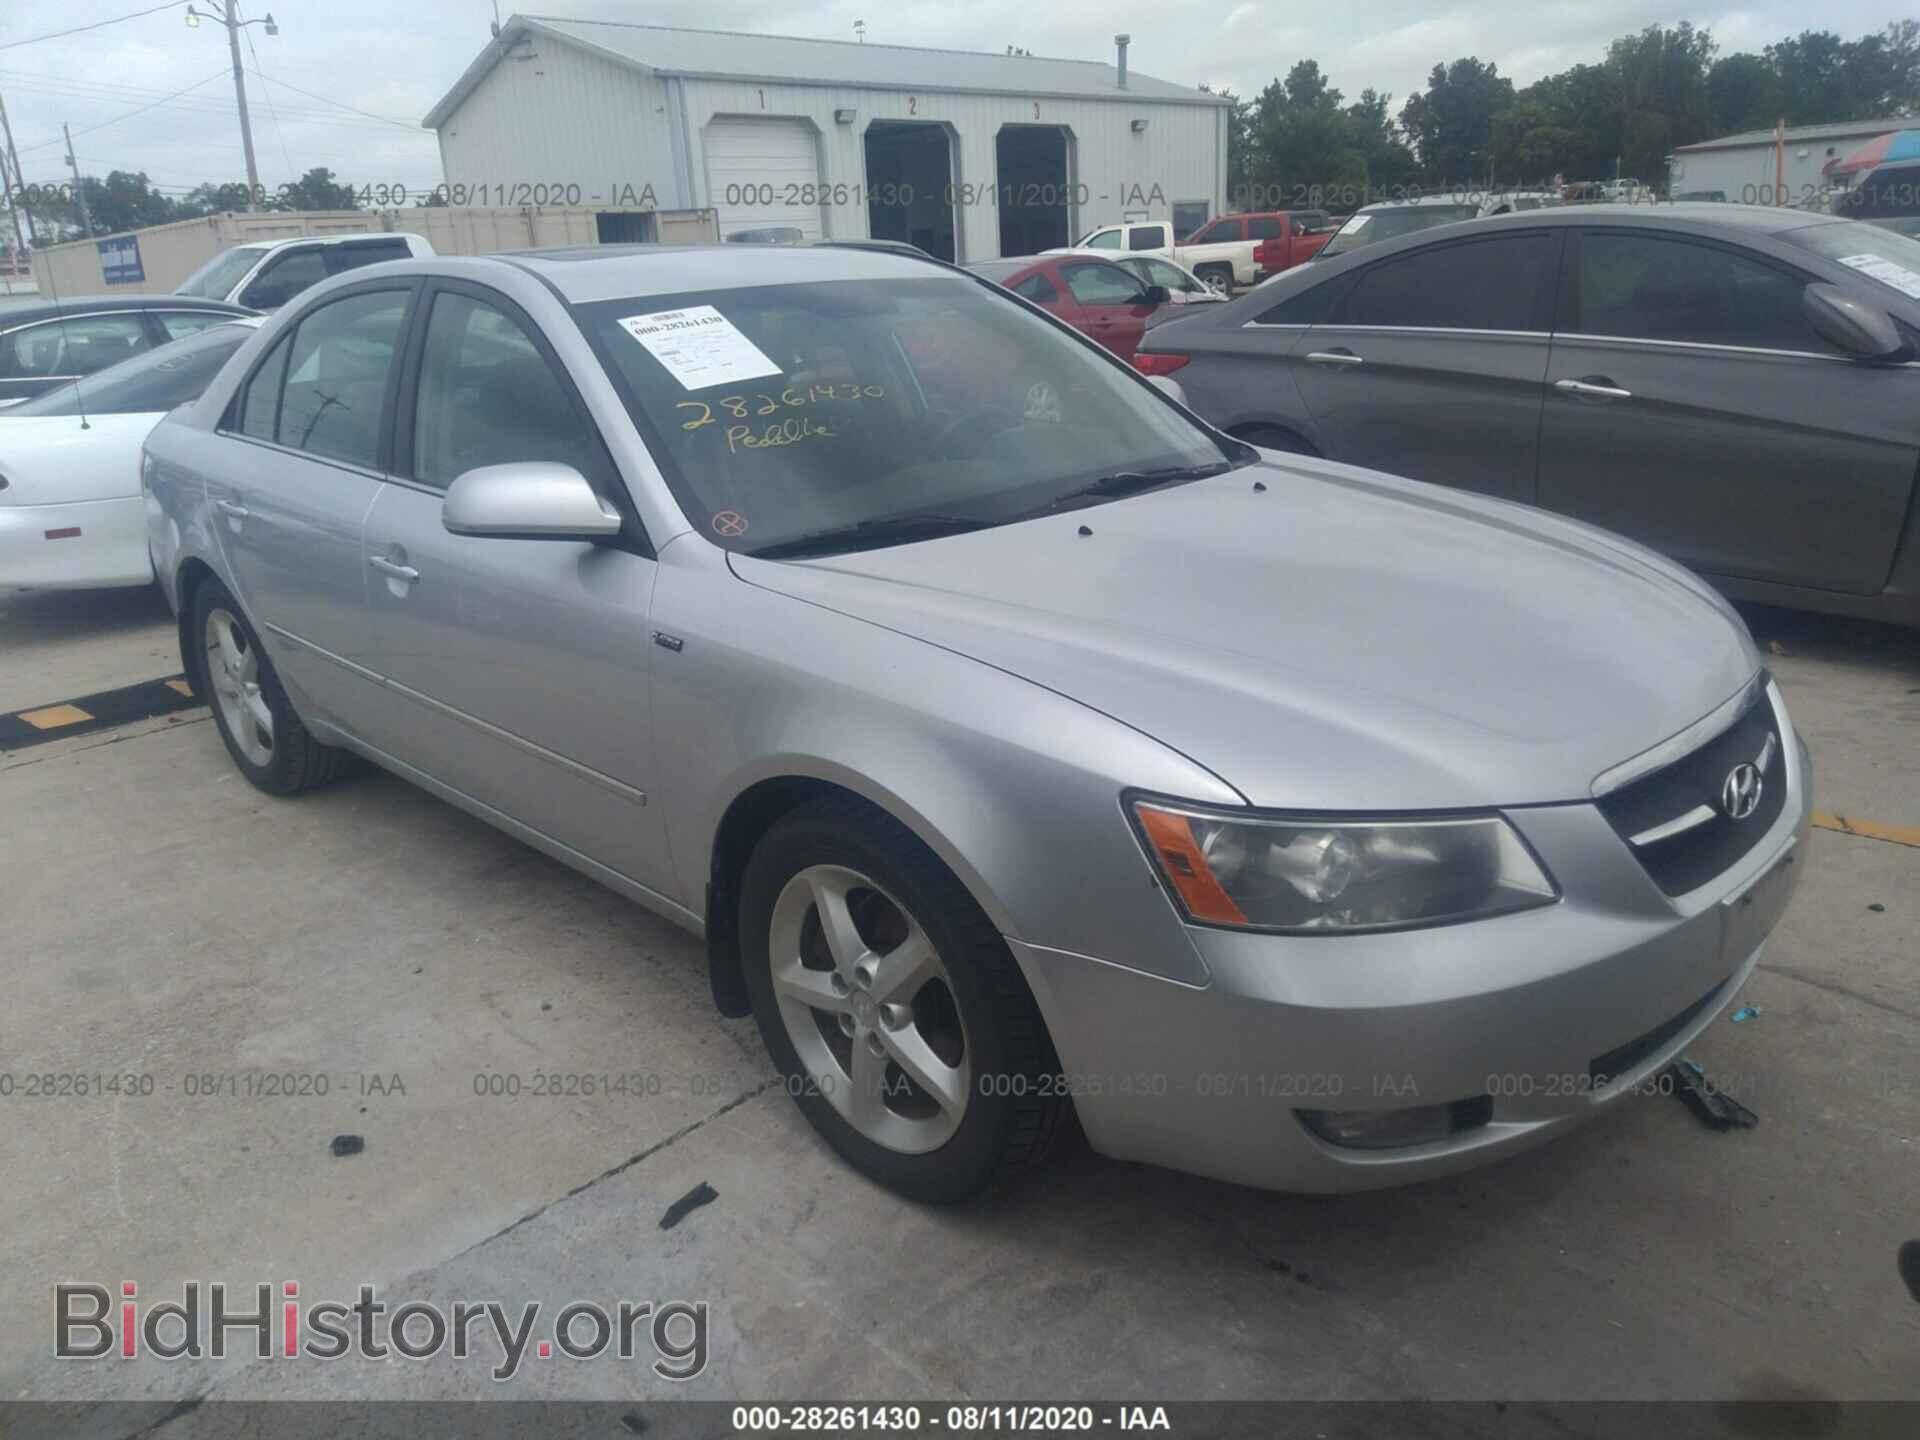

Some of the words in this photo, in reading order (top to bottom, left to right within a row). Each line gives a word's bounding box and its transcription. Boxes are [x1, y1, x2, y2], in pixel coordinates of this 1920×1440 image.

[758, 89, 765, 109] 1
[909, 97, 917, 115] 2
[1033, 103, 1040, 120] 3
